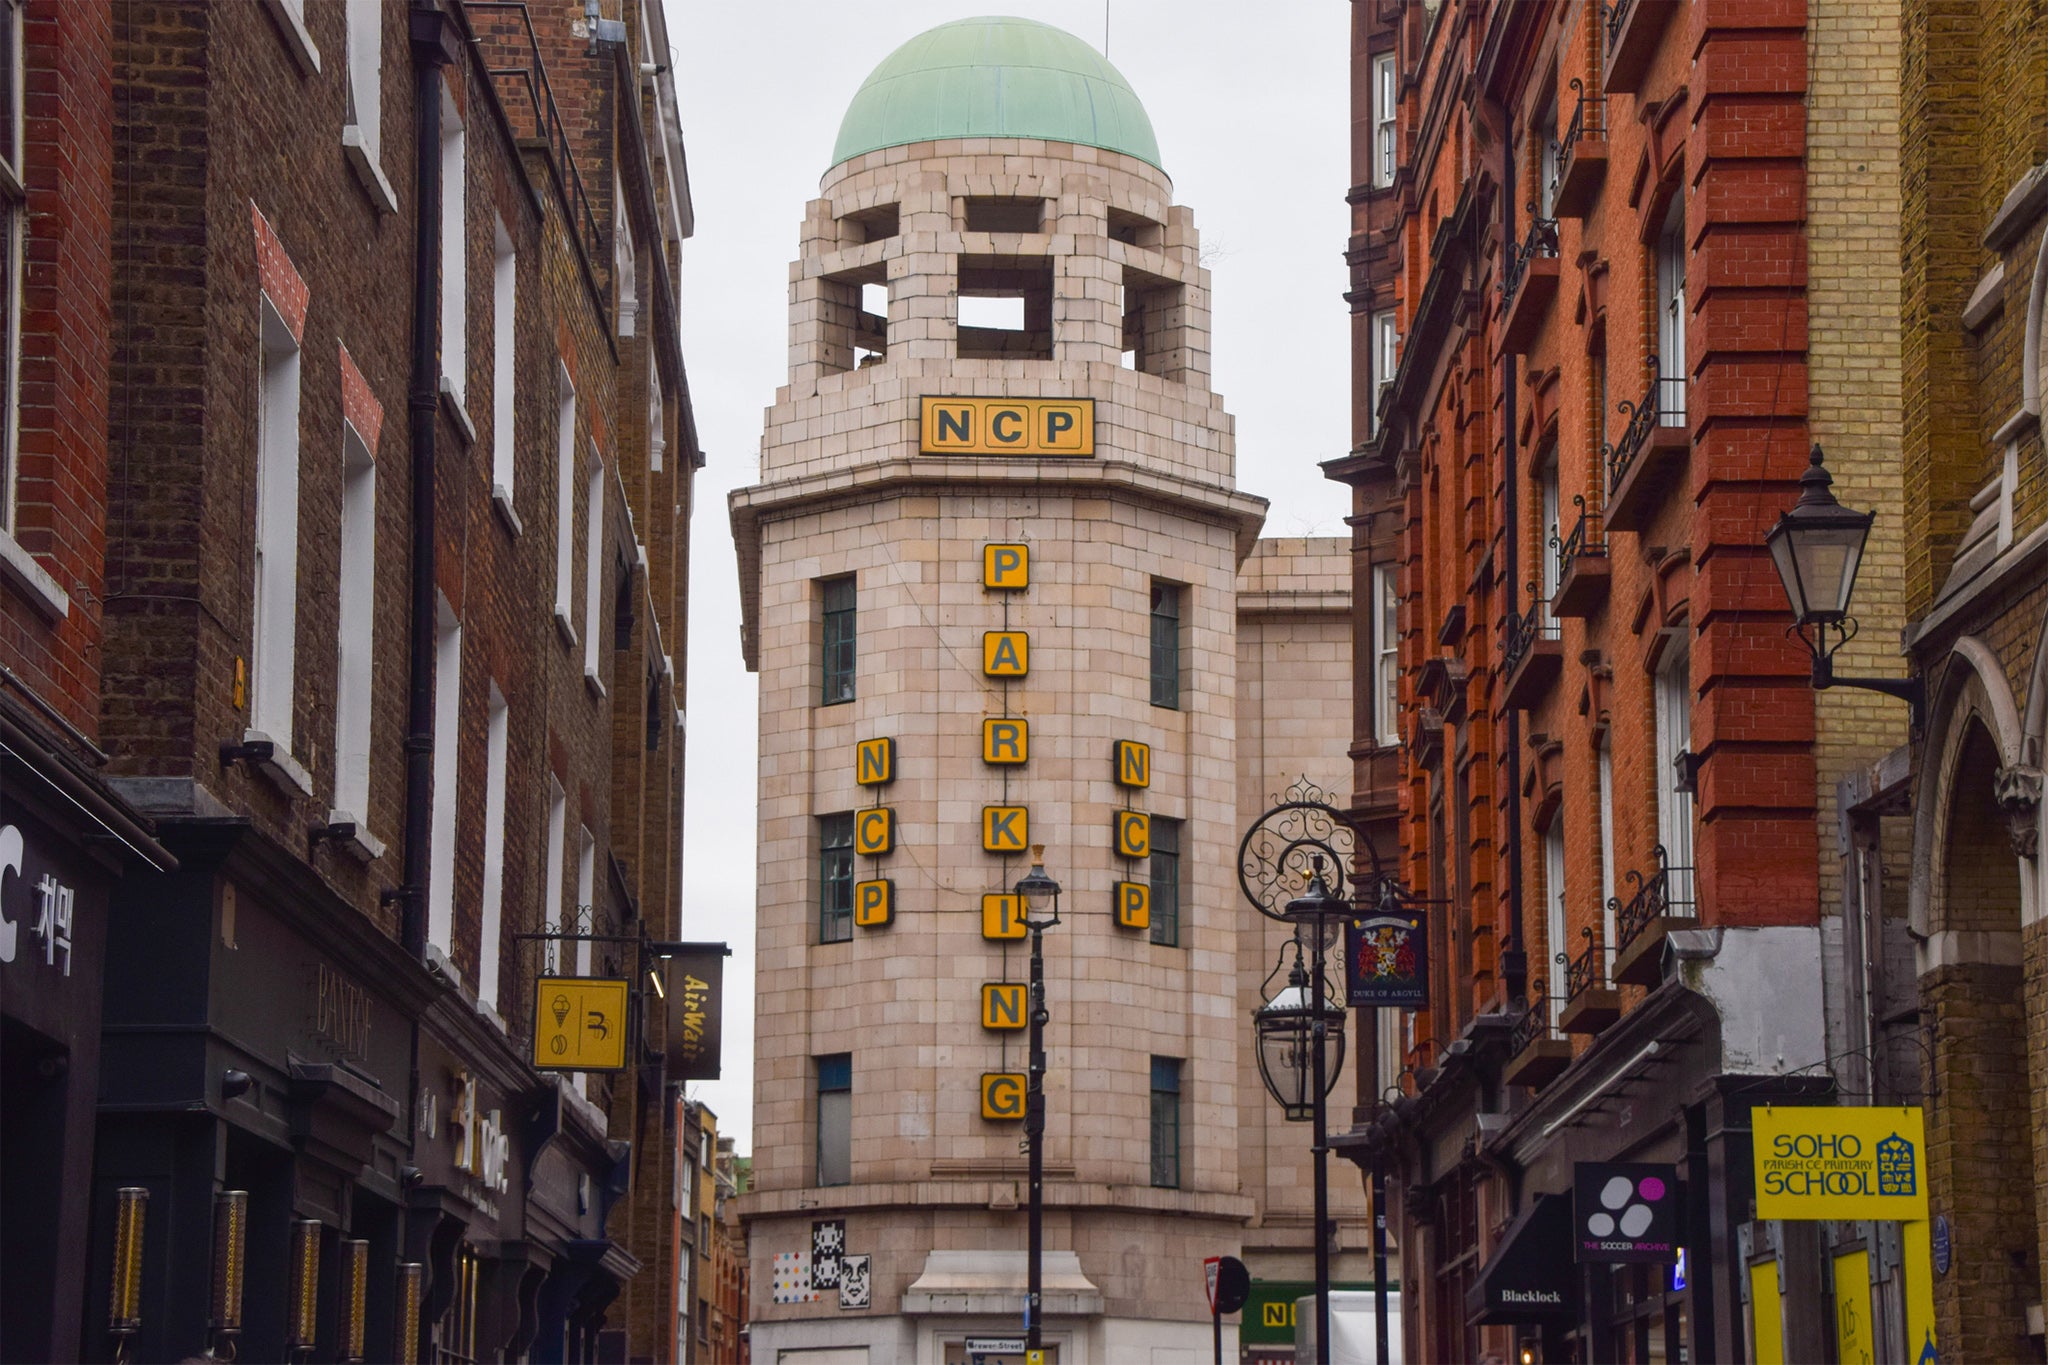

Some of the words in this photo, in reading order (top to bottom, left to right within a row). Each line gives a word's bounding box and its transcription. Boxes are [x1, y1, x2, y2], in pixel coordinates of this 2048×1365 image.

[937, 409, 1074, 443] NCP
[861, 744, 885, 921] NCP
[987, 549, 1021, 1114] PARKING
[1124, 746, 1145, 922] NCP
[37, 873, 75, 976] 치맥
[682, 974, 709, 1060] AirWair
[1773, 1134, 1861, 1158] SOHO
[1763, 1160, 1803, 1170] PARISH
[1805, 1160, 1822, 1170] CE
[1824, 1160, 1873, 1170] PRIMARY
[1765, 1171, 1875, 1195] SCHOOL
[1583, 1241, 1599, 1250] THE
[1600, 1242, 1633, 1250] SOCCER
[1634, 1242, 1670, 1251] ARCHIVE
[1502, 1289, 1561, 1303] Blacklock
[999, 1341, 1022, 1350] Street
